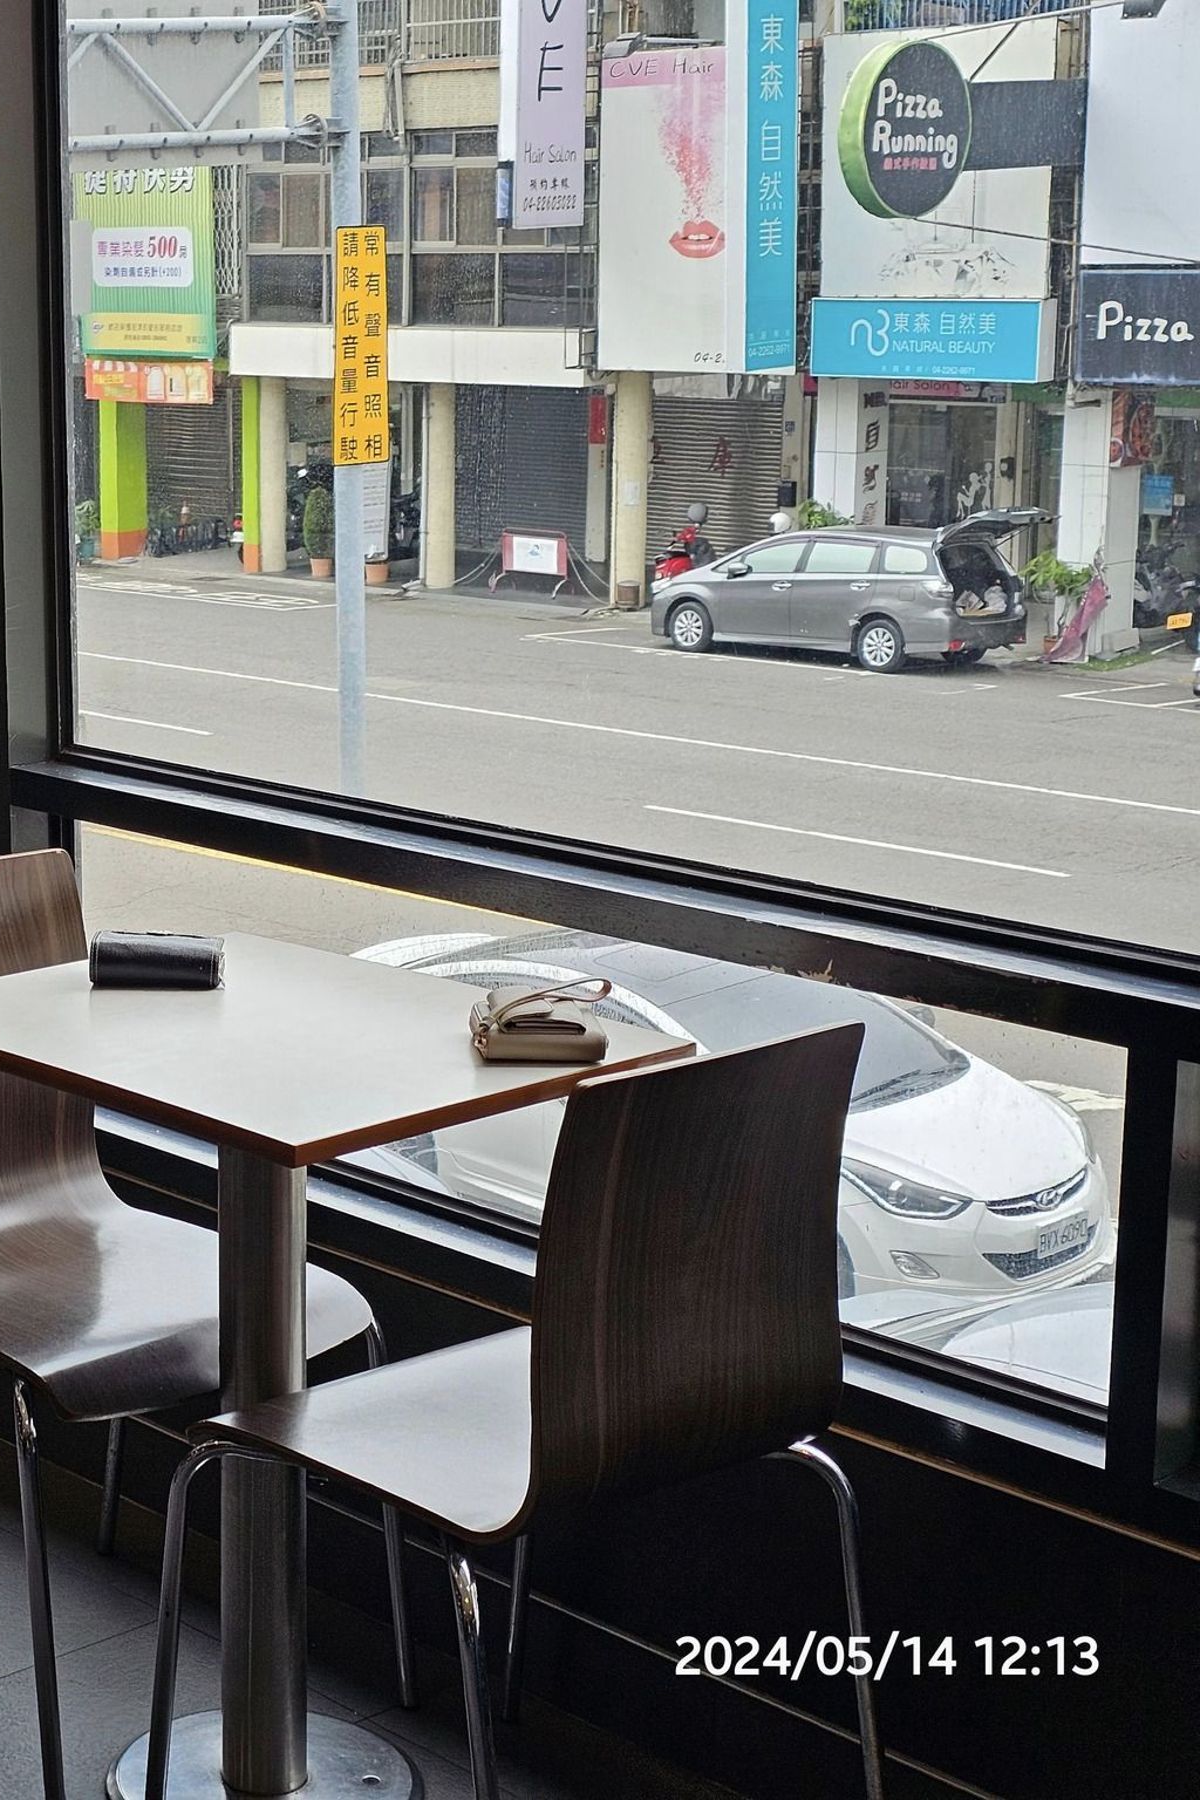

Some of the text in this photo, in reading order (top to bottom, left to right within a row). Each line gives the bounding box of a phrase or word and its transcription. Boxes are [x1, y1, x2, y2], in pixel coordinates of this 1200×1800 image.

[610, 57, 715, 78] CVE Hair
[876, 78, 944, 118] Pizza
[524, 141, 577, 163] Hair Salon
[758, 13, 785, 258] 東森 自然美
[872, 119, 959, 169] Running
[892, 312, 997, 335] 東森 自然美
[1096, 300, 1195, 343] Pizza
[340, 232, 360, 462] 請降低音量行駛
[364, 231, 383, 460] 常有聲音照相
[892, 340, 996, 354] NATURAL BEAUTY
